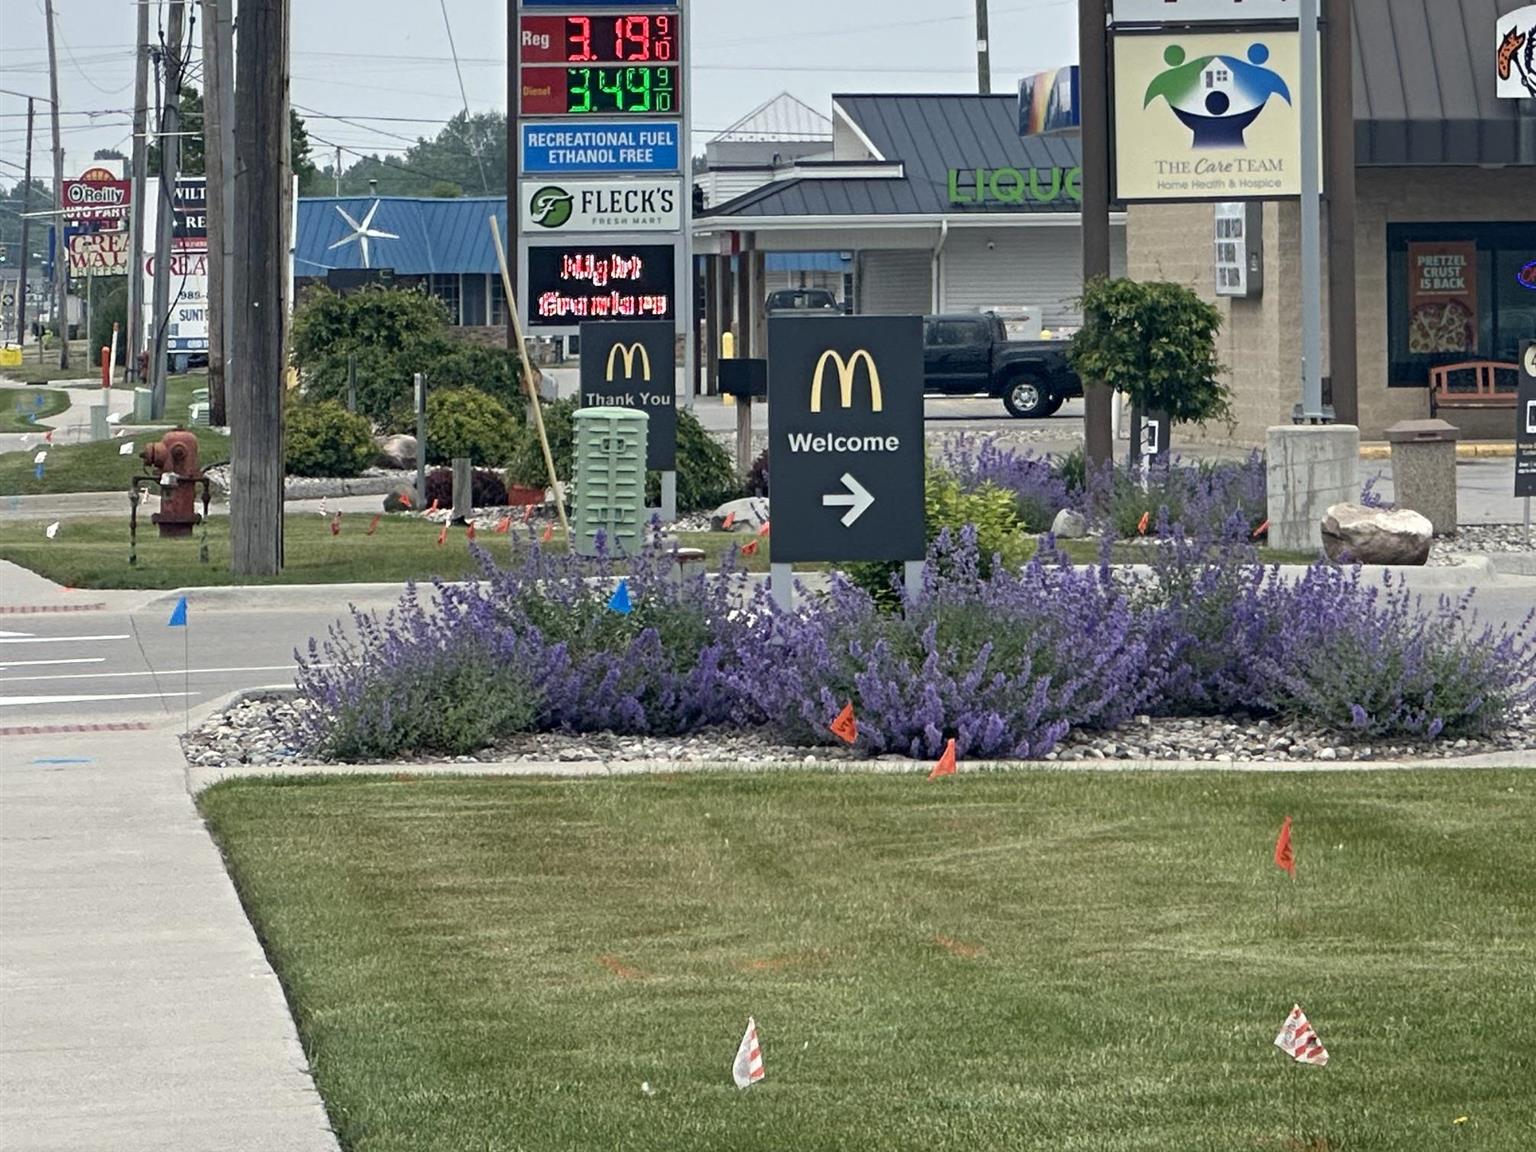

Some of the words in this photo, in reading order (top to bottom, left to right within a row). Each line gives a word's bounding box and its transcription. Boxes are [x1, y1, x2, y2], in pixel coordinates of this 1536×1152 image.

[522, 30, 549, 49] Reg
[567, 15, 650, 61] 3.19
[523, 86, 551, 96] Diesel
[528, 132, 636, 147] RECREATIONAL
[639, 131, 674, 146] FUEL
[549, 149, 616, 164] ETHANOL
[619, 148, 653, 163] FREE
[1155, 160, 1191, 175] THE
[1194, 157, 1233, 176] Care
[1233, 158, 1284, 173] TEAM
[1157, 180, 1188, 190] Home
[1191, 179, 1227, 190] Health
[1228, 179, 1237, 189] &
[1239, 178, 1282, 190] Hospice
[68, 183, 124, 205] O'Reilly
[581, 187, 674, 214] FLECK'S
[592, 217, 628, 225] FRESH
[632, 216, 663, 225] MART
[1417, 255, 1467, 266] PRETZEL
[1423, 266, 1462, 278] CRUST
[1420, 278, 1433, 289] IS
[1434, 277, 1465, 289] BACK
[179, 309, 209, 321] SUNT
[586, 392, 635, 406] Thank
[639, 392, 670, 406] You
[788, 432, 900, 453] Welcome
